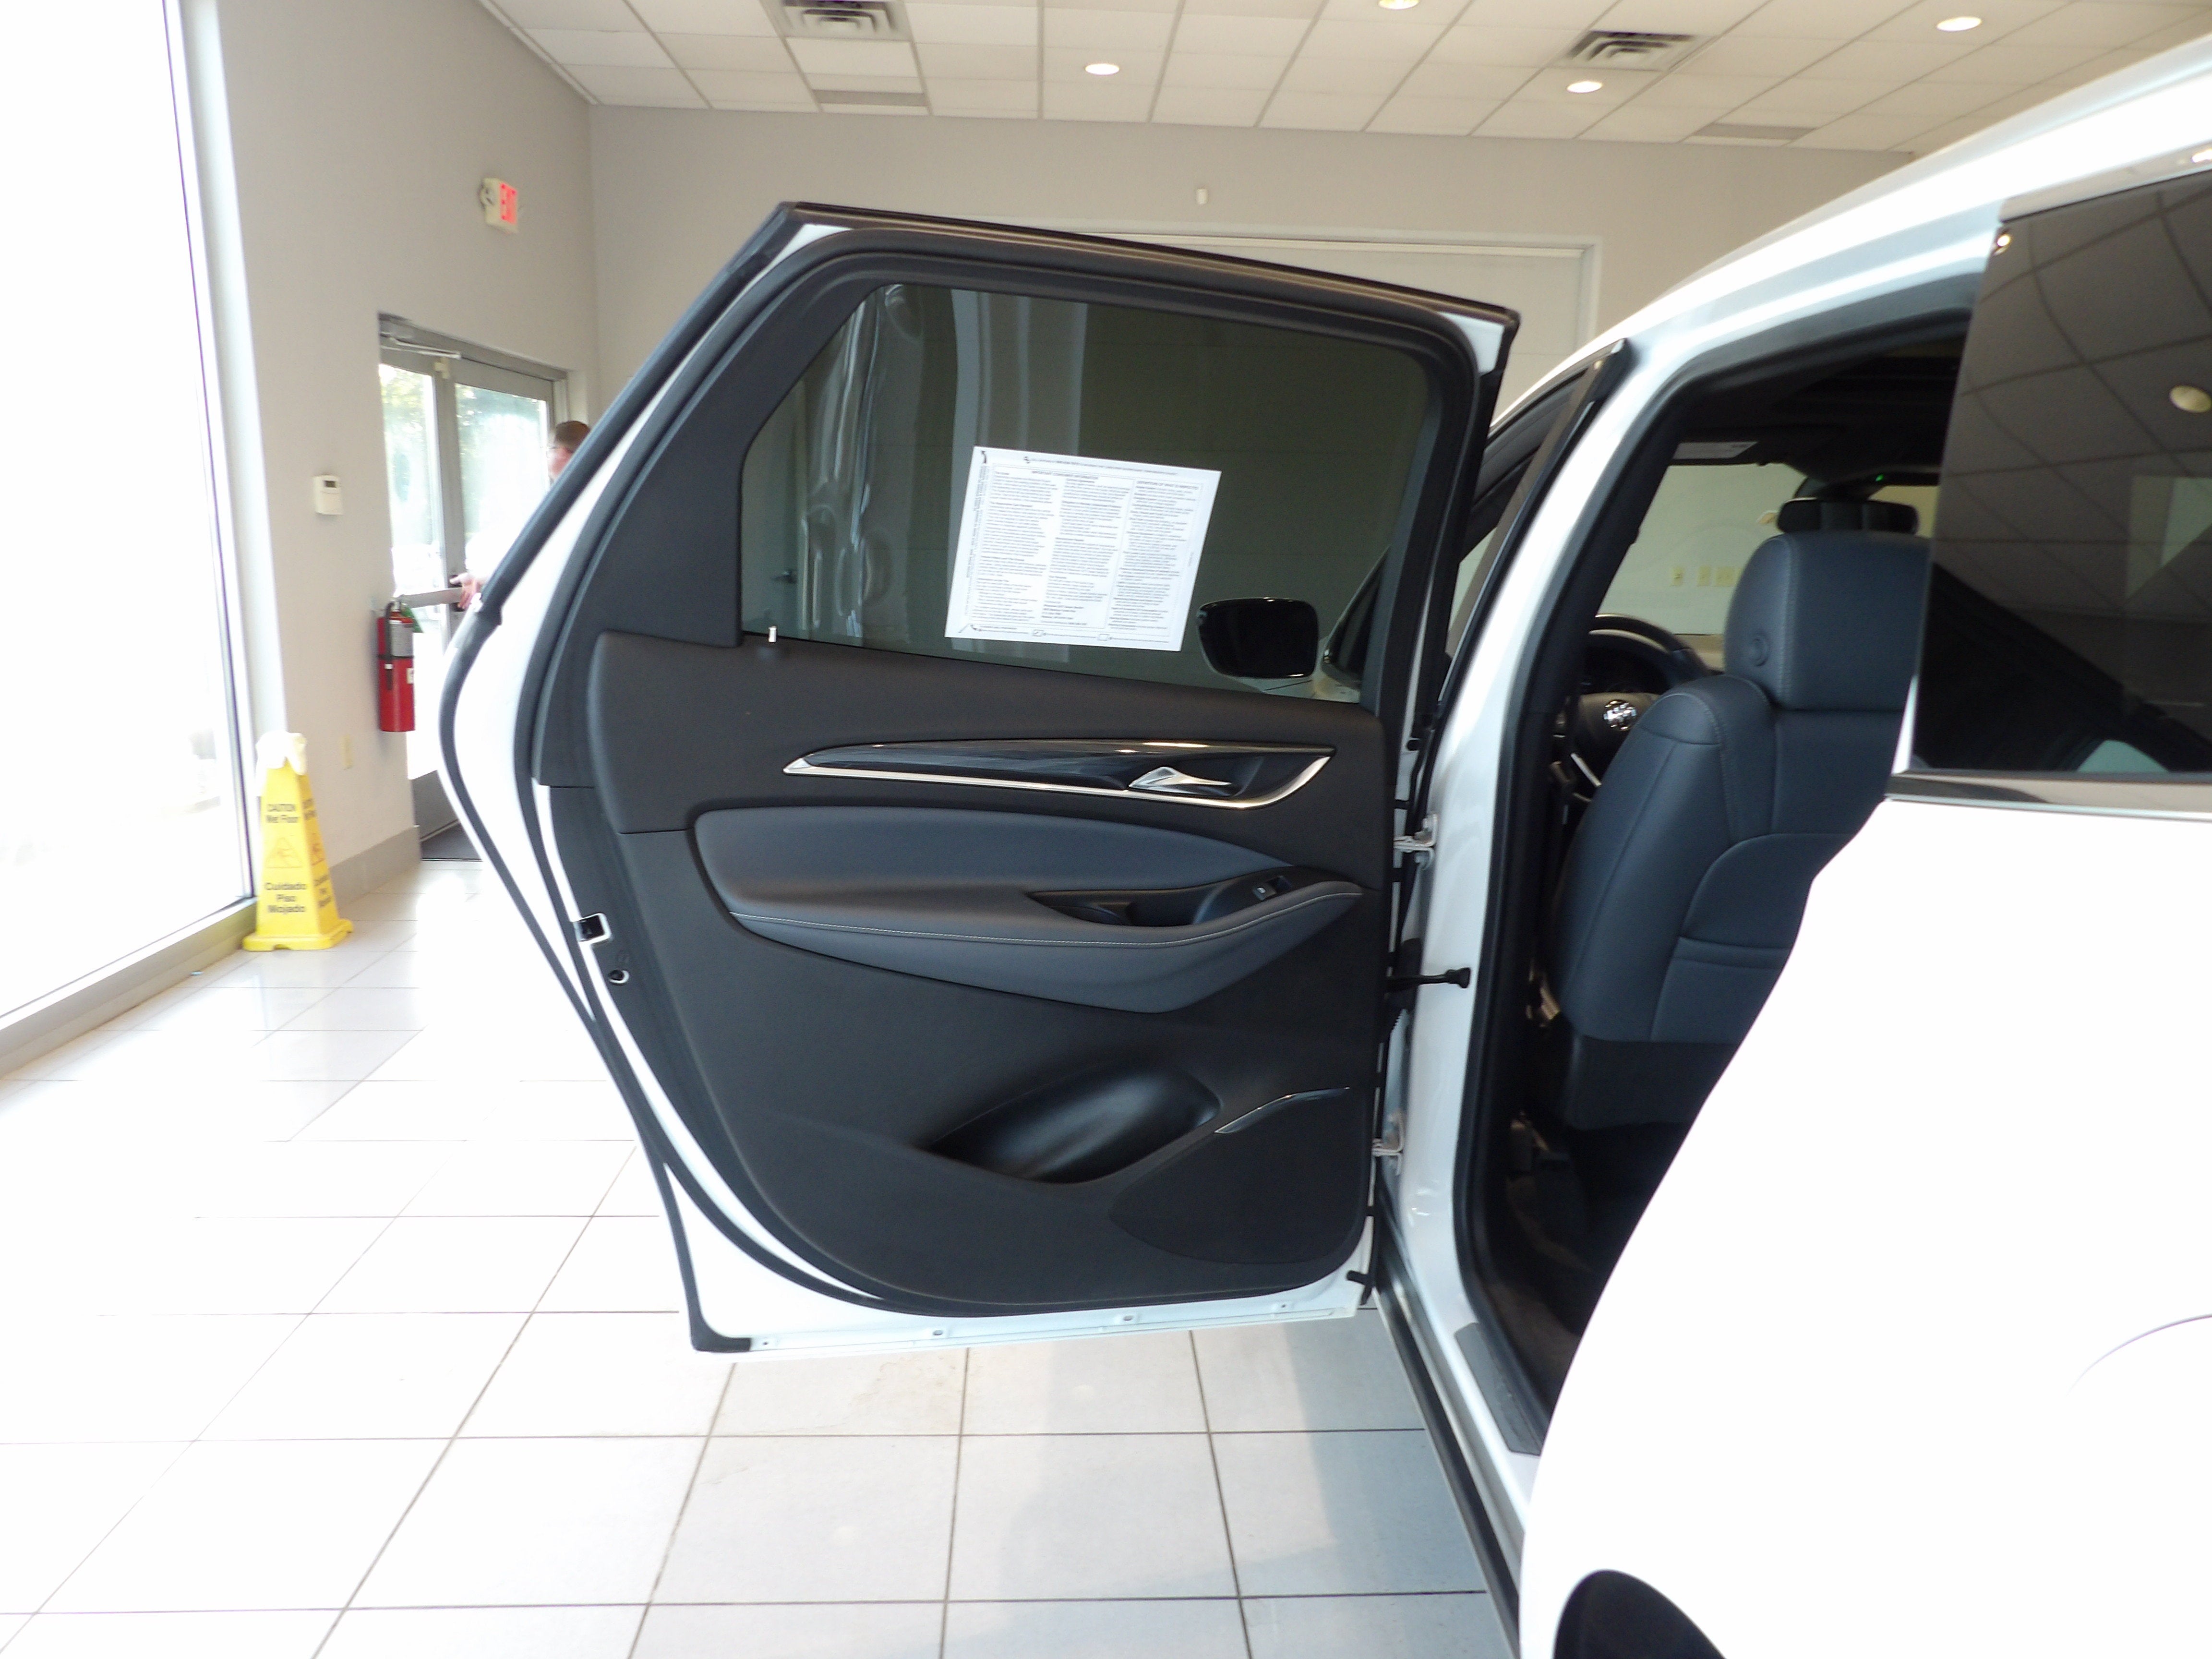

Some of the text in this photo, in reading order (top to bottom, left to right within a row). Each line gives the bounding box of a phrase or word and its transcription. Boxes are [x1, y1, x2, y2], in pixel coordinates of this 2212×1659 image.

[267, 804, 296, 812] CAUTION
[265, 882, 307, 890] Cuidado
[267, 905, 306, 914] Mojado
